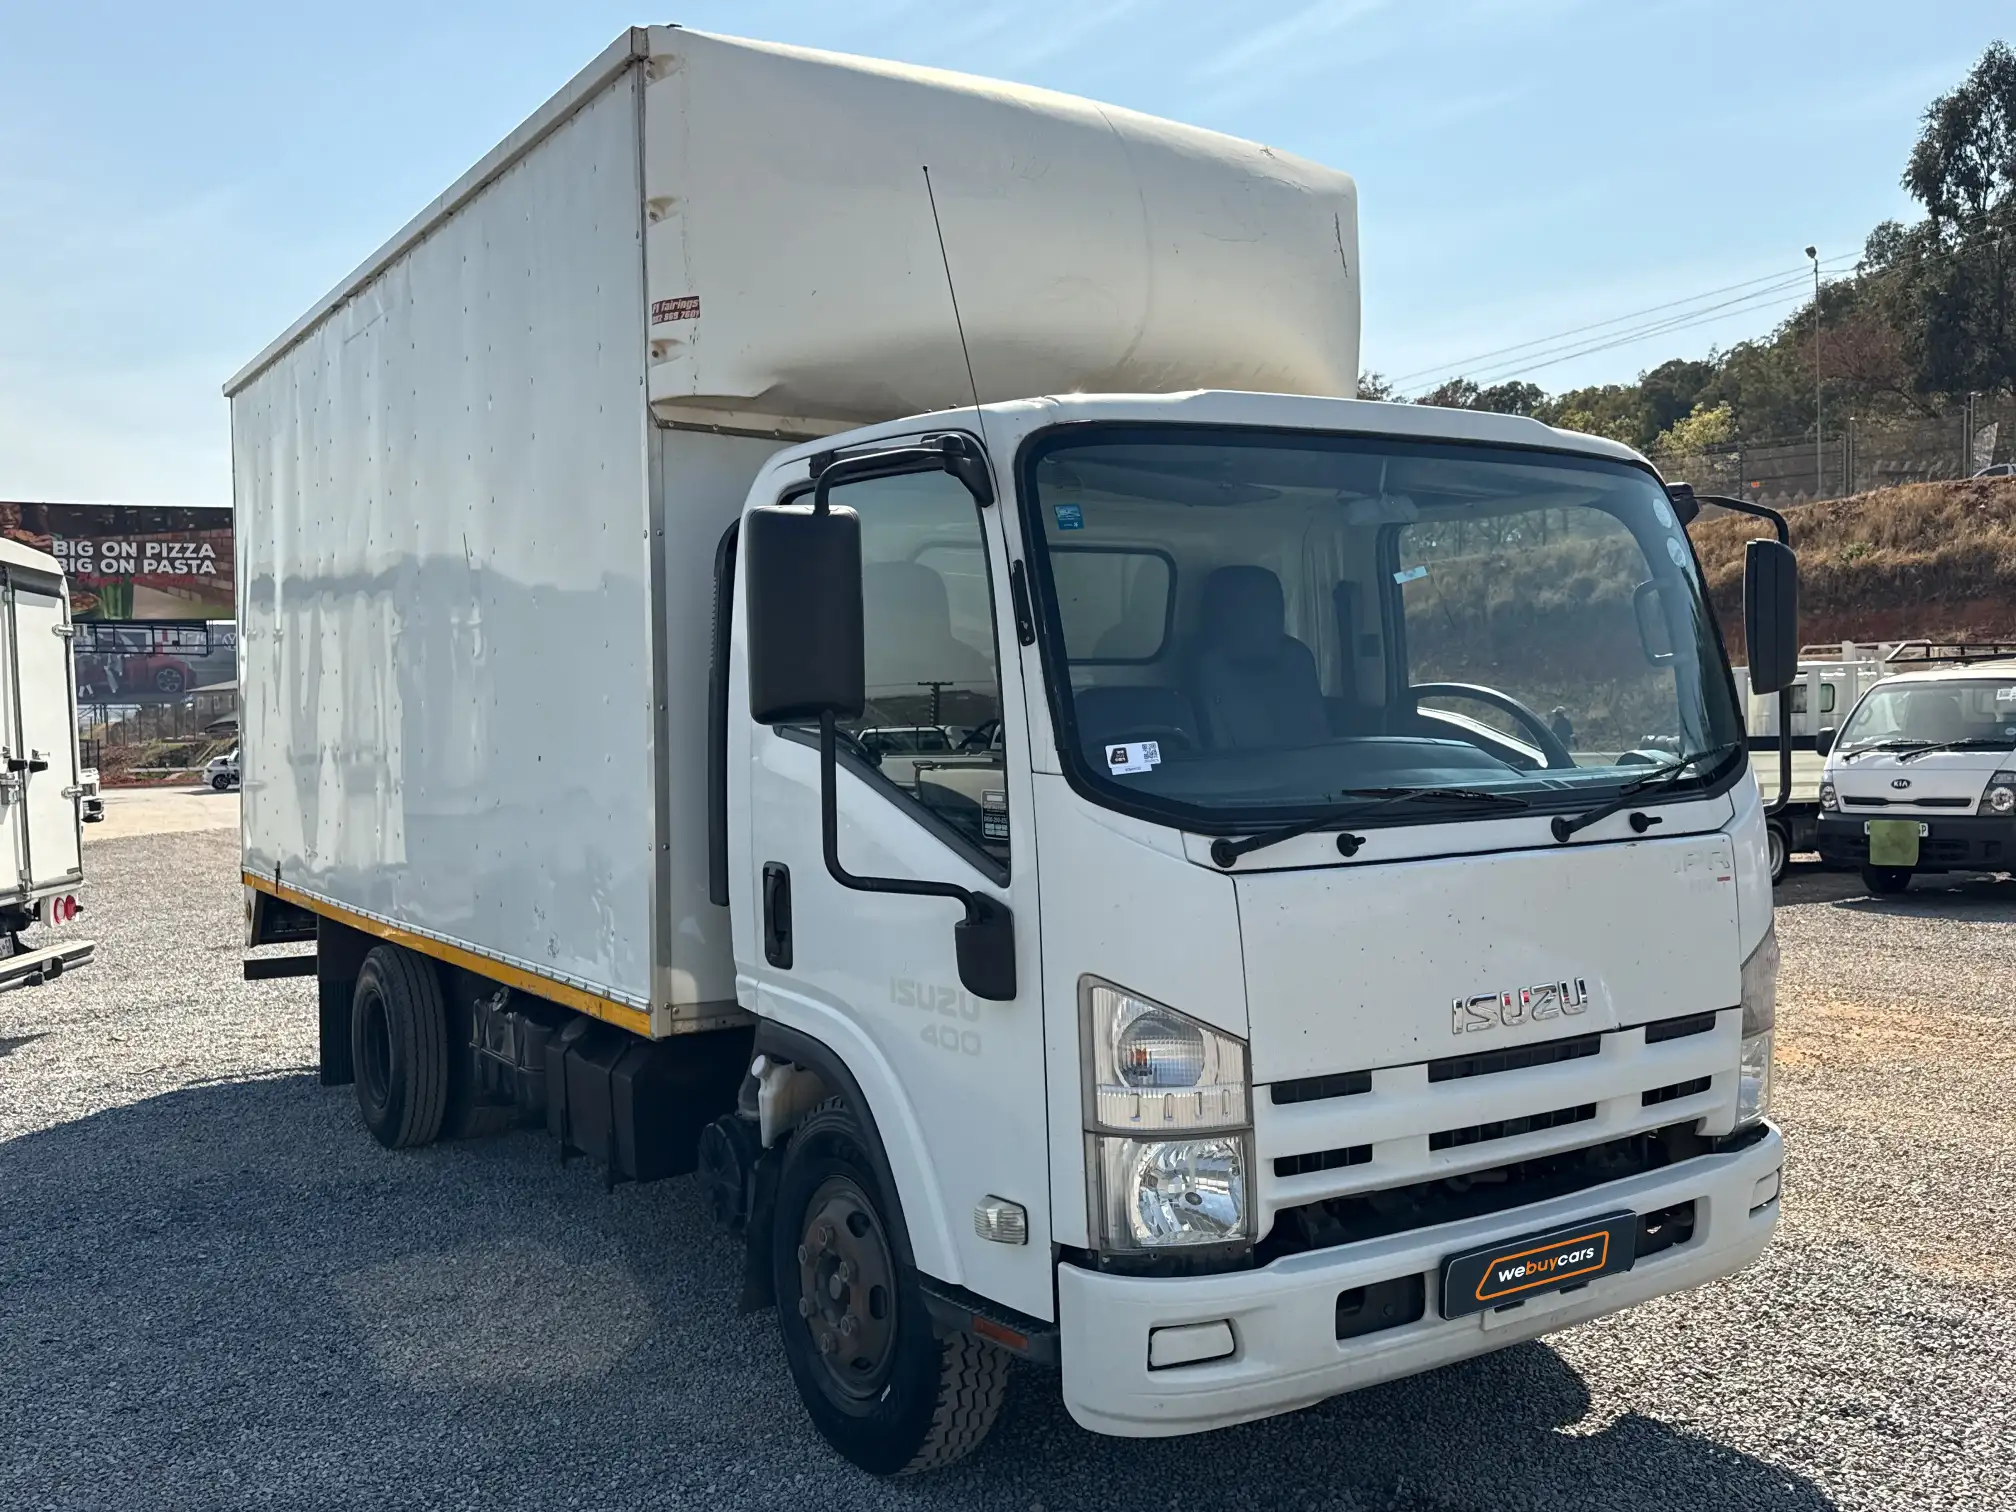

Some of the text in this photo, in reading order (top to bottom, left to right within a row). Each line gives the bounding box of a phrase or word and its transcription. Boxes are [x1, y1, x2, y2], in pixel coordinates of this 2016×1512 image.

[661, 299, 698, 311] fairings
[52, 540, 216, 559] BIG ON PIZZA
[58, 558, 217, 575] BIG ON PASTA
[1893, 780, 1908, 788] KIA
[890, 976, 980, 1022] ISUZU
[1452, 976, 1588, 1035] ISUZU
[920, 1022, 982, 1056] 400
[1498, 1246, 1595, 1283] webuycars
